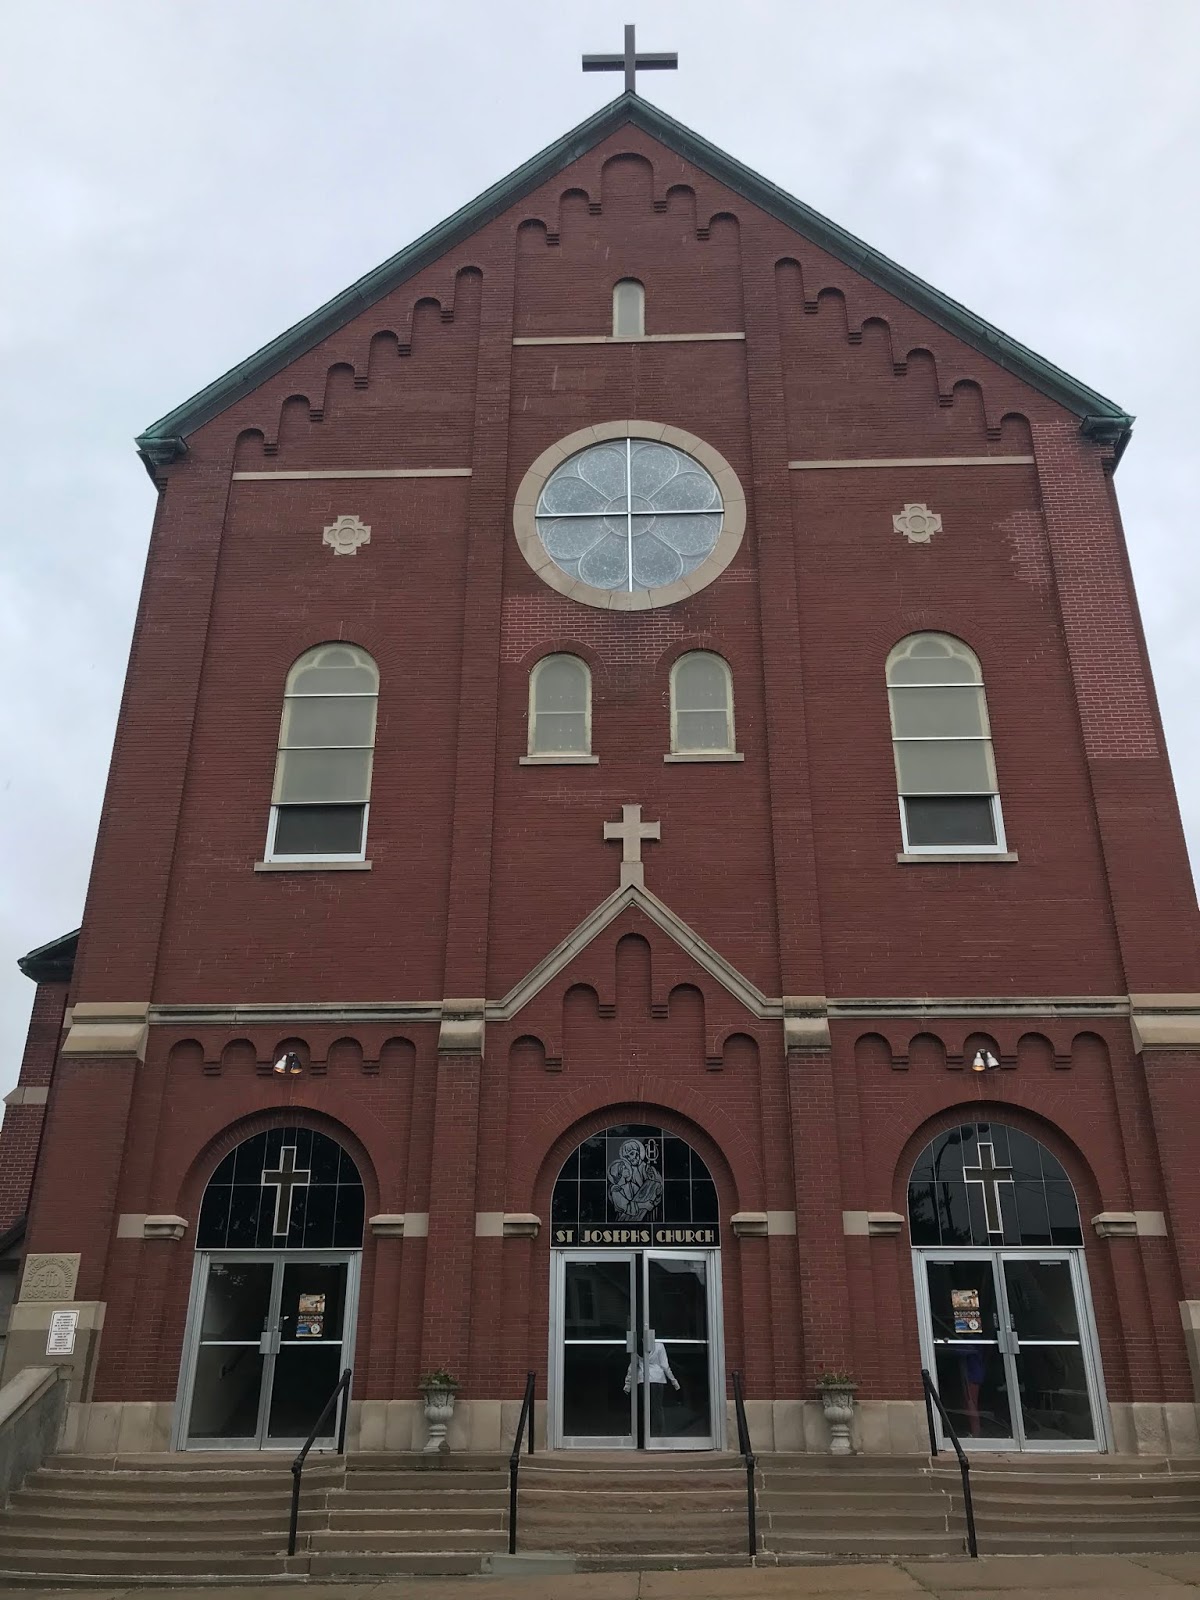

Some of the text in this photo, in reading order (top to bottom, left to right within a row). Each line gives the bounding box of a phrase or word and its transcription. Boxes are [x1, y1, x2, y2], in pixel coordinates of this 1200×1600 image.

[556, 1230, 715, 1243] ST JOSEPHS CHURCH
